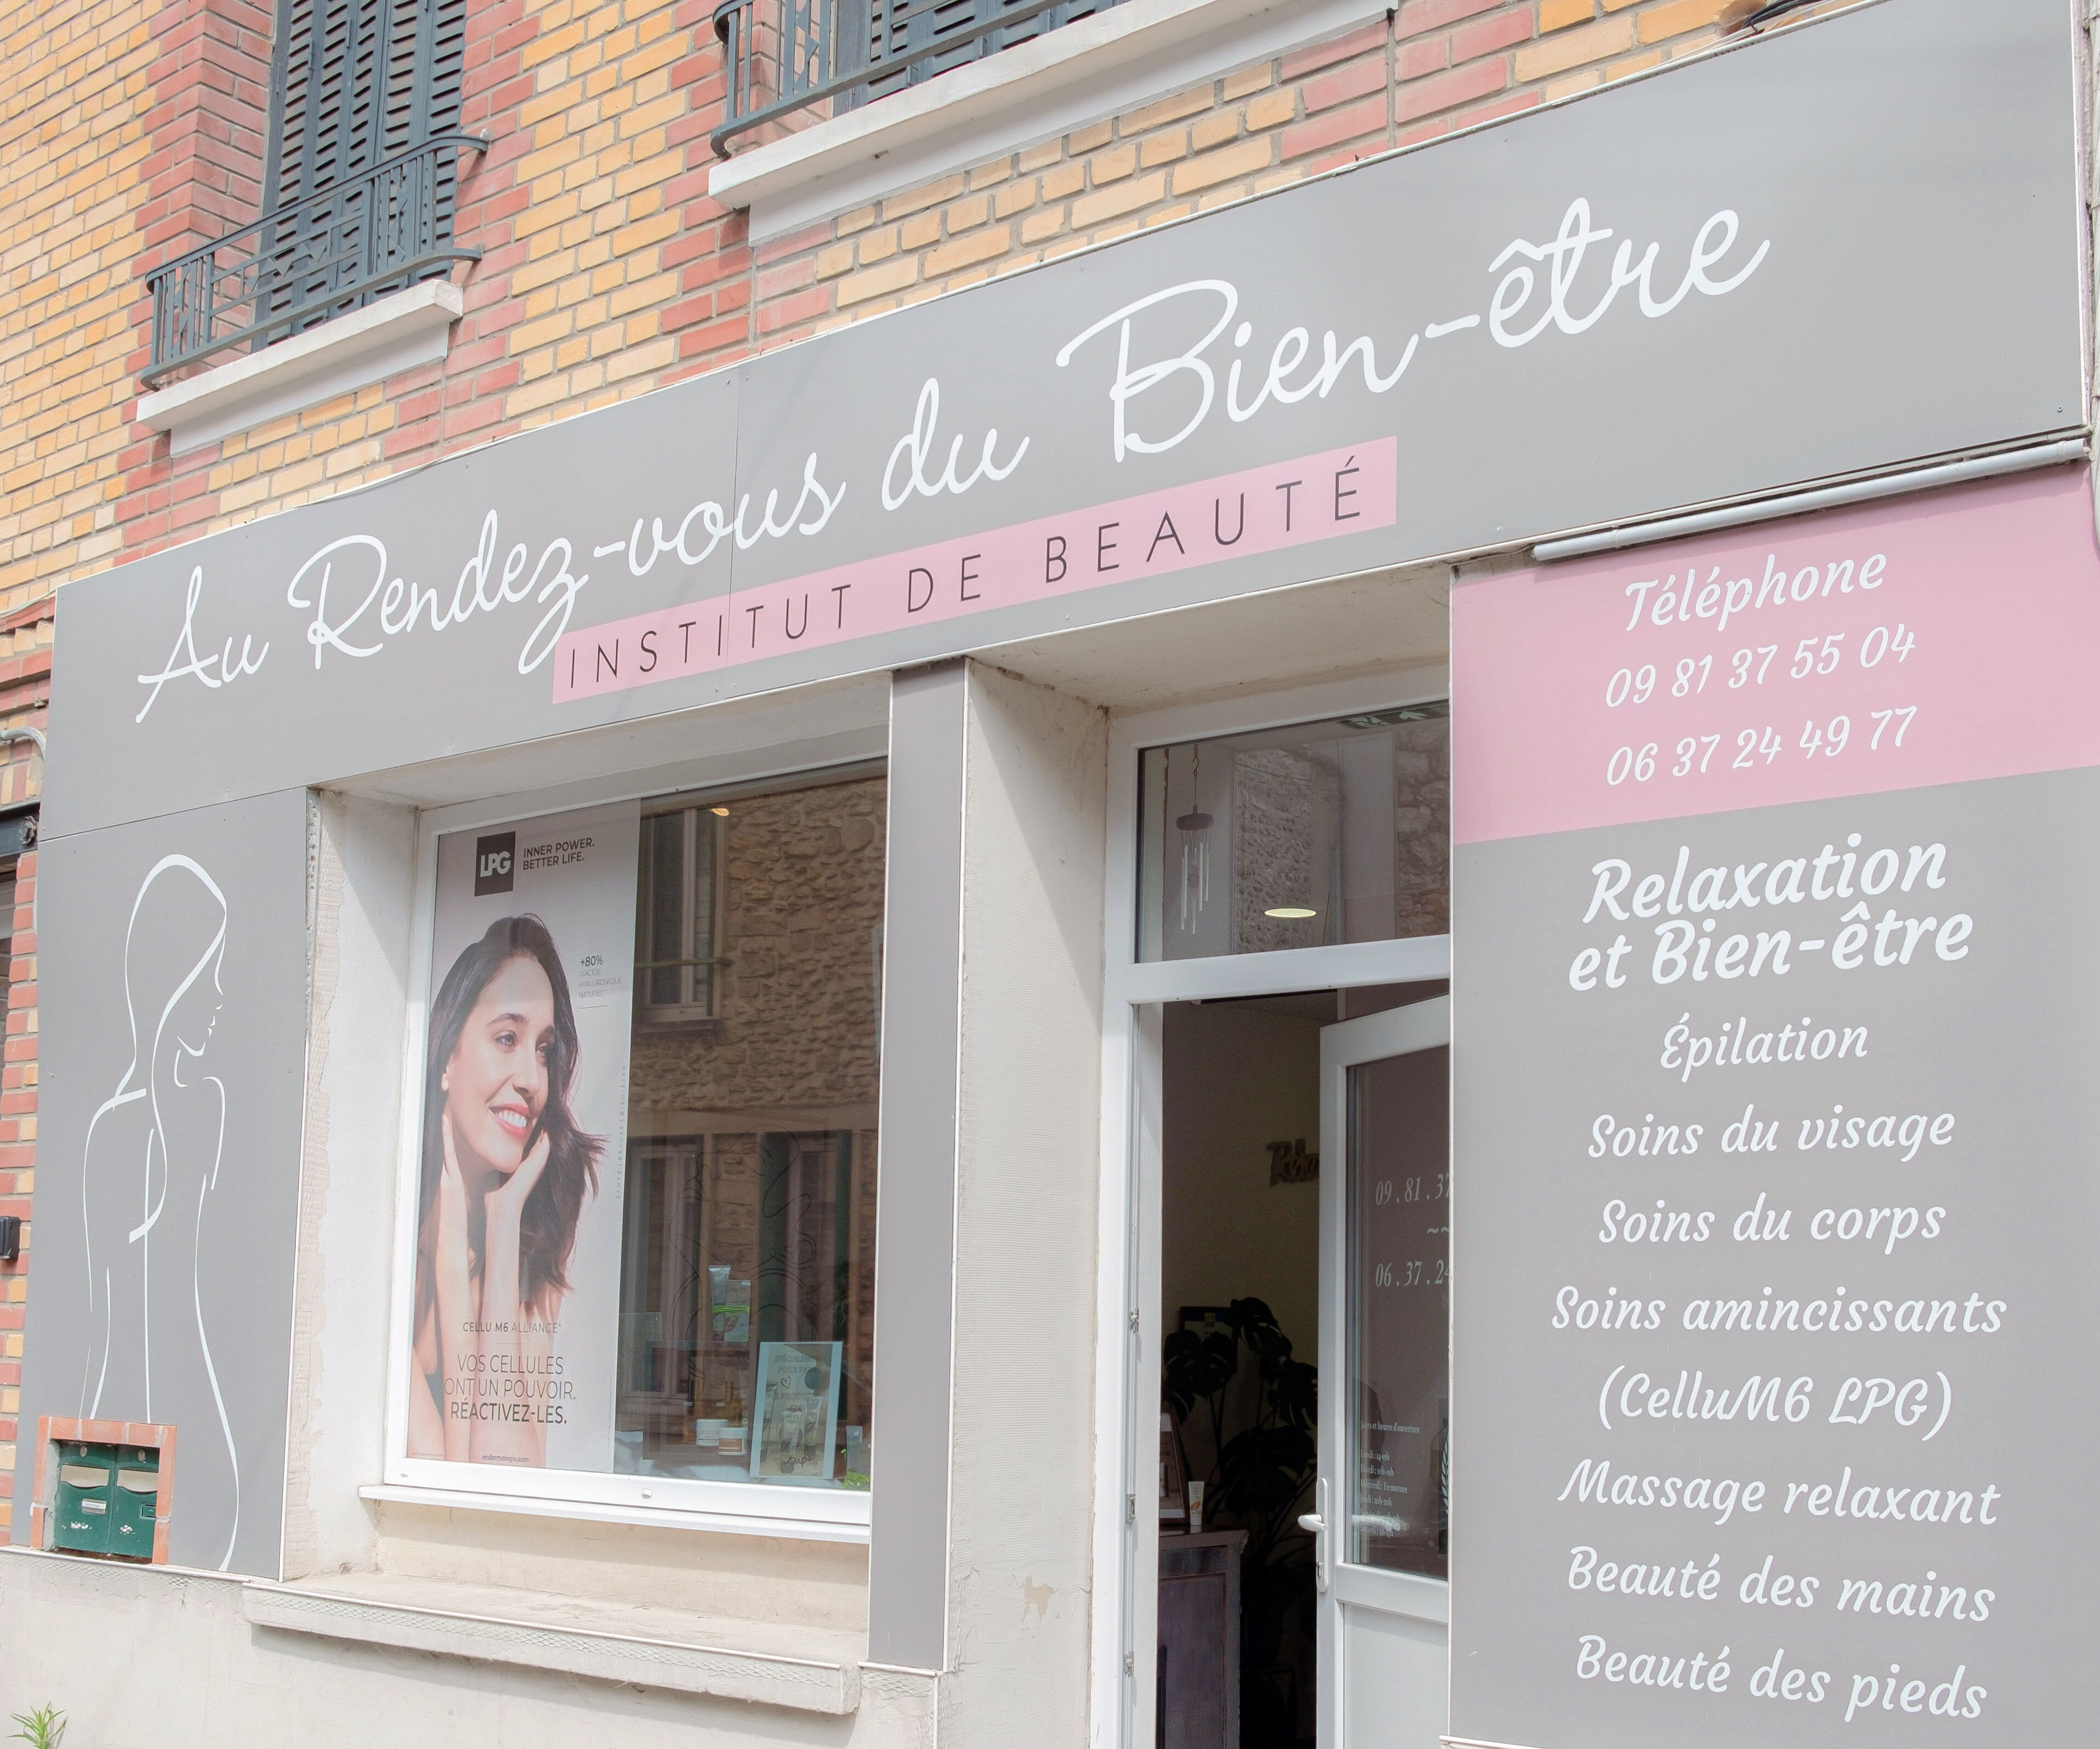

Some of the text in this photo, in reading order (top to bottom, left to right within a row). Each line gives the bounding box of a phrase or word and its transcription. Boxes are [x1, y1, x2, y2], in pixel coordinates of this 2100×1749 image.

[136, 196, 1770, 723] Au Rendez-vous du Bien-être
[571, 456, 1359, 688] INSTITUT DE BEAUTÉ
[1626, 554, 1886, 631] Téléphone
[1607, 623, 1915, 707] 09 81 37 55 04
[1607, 706, 1917, 785] 06 37 24 49 77
[480, 851, 511, 877] LPG
[523, 838, 595, 858] INNER POWER.
[523, 852, 585, 870] BETTER LIFE.
[1583, 833, 1945, 923] Relaxation
[581, 955, 604, 967] +80%
[1569, 901, 1972, 990] et Bien-être
[1661, 1012, 1867, 1083] Épilation
[1589, 1104, 1954, 1161] Soins du visage
[1599, 1192, 1946, 1255] Soins du corps
[463, 1321, 492, 1332] CELLU
[495, 1321, 508, 1332] M6
[1552, 1286, 2006, 1332] Soins amincissants
[444, 1378, 576, 1399] ONT UN POUVOIR.
[458, 1354, 564, 1375] VOS CELLULES
[451, 1398, 567, 1424] RÉACTIVEZ-LES.
[1600, 1365, 1951, 1440] (CelluM6 LPG)
[1557, 1459, 2001, 1525] Massage relaxant
[1569, 1546, 1995, 1621] Beauté des mains
[1577, 1635, 1987, 1722] Beauté des pieds
